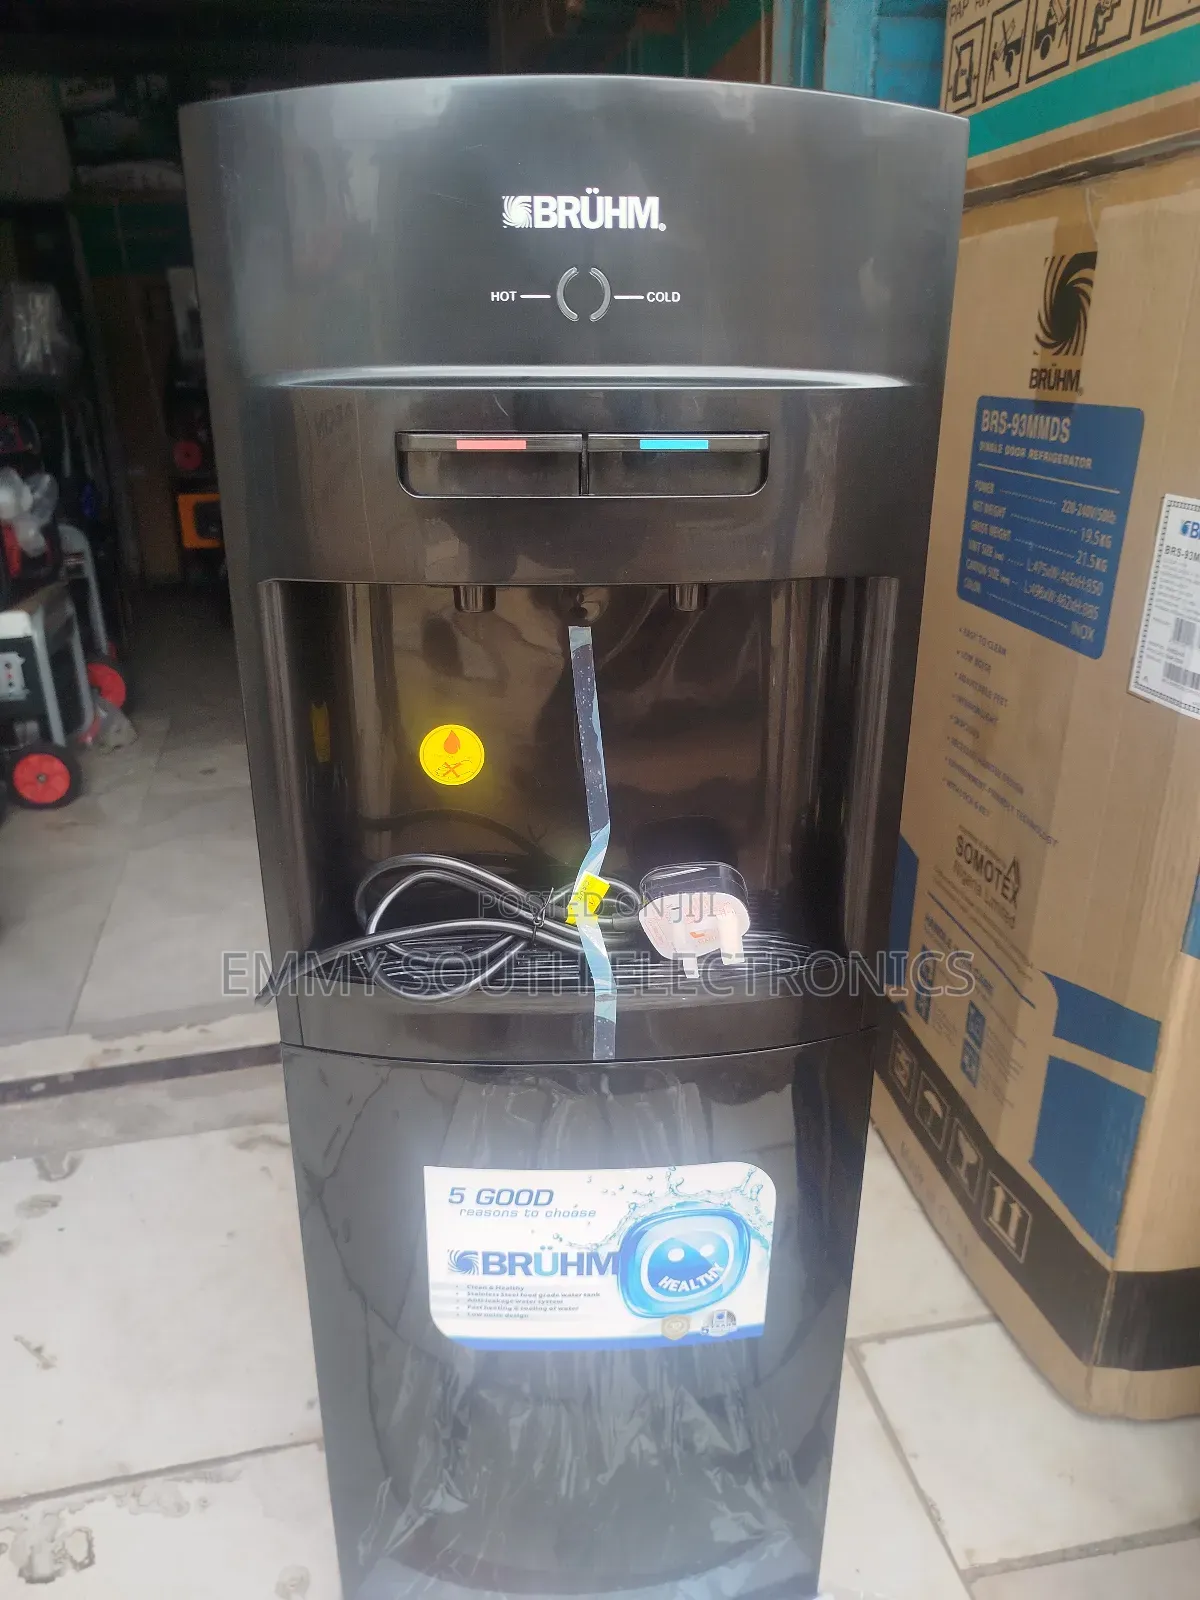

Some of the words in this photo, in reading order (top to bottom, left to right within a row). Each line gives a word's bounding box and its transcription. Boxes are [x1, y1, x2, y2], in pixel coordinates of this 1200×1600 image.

[490, 290, 518, 302] HOT
[646, 291, 681, 302] COLD
[980, 409, 1072, 444] BRS-93MMDS
[1028, 448, 1093, 470] REFRIGERATOR
[955, 834, 1021, 910] SOMOTEX
[448, 1187, 466, 1204] 5
[475, 1188, 555, 1207] GOOD
[459, 1208, 518, 1218] reasons
[524, 1208, 539, 1218] to
[545, 1207, 597, 1218] choose
[481, 1245, 619, 1276] BRÜHM
[658, 1262, 725, 1292] HEALTHY
